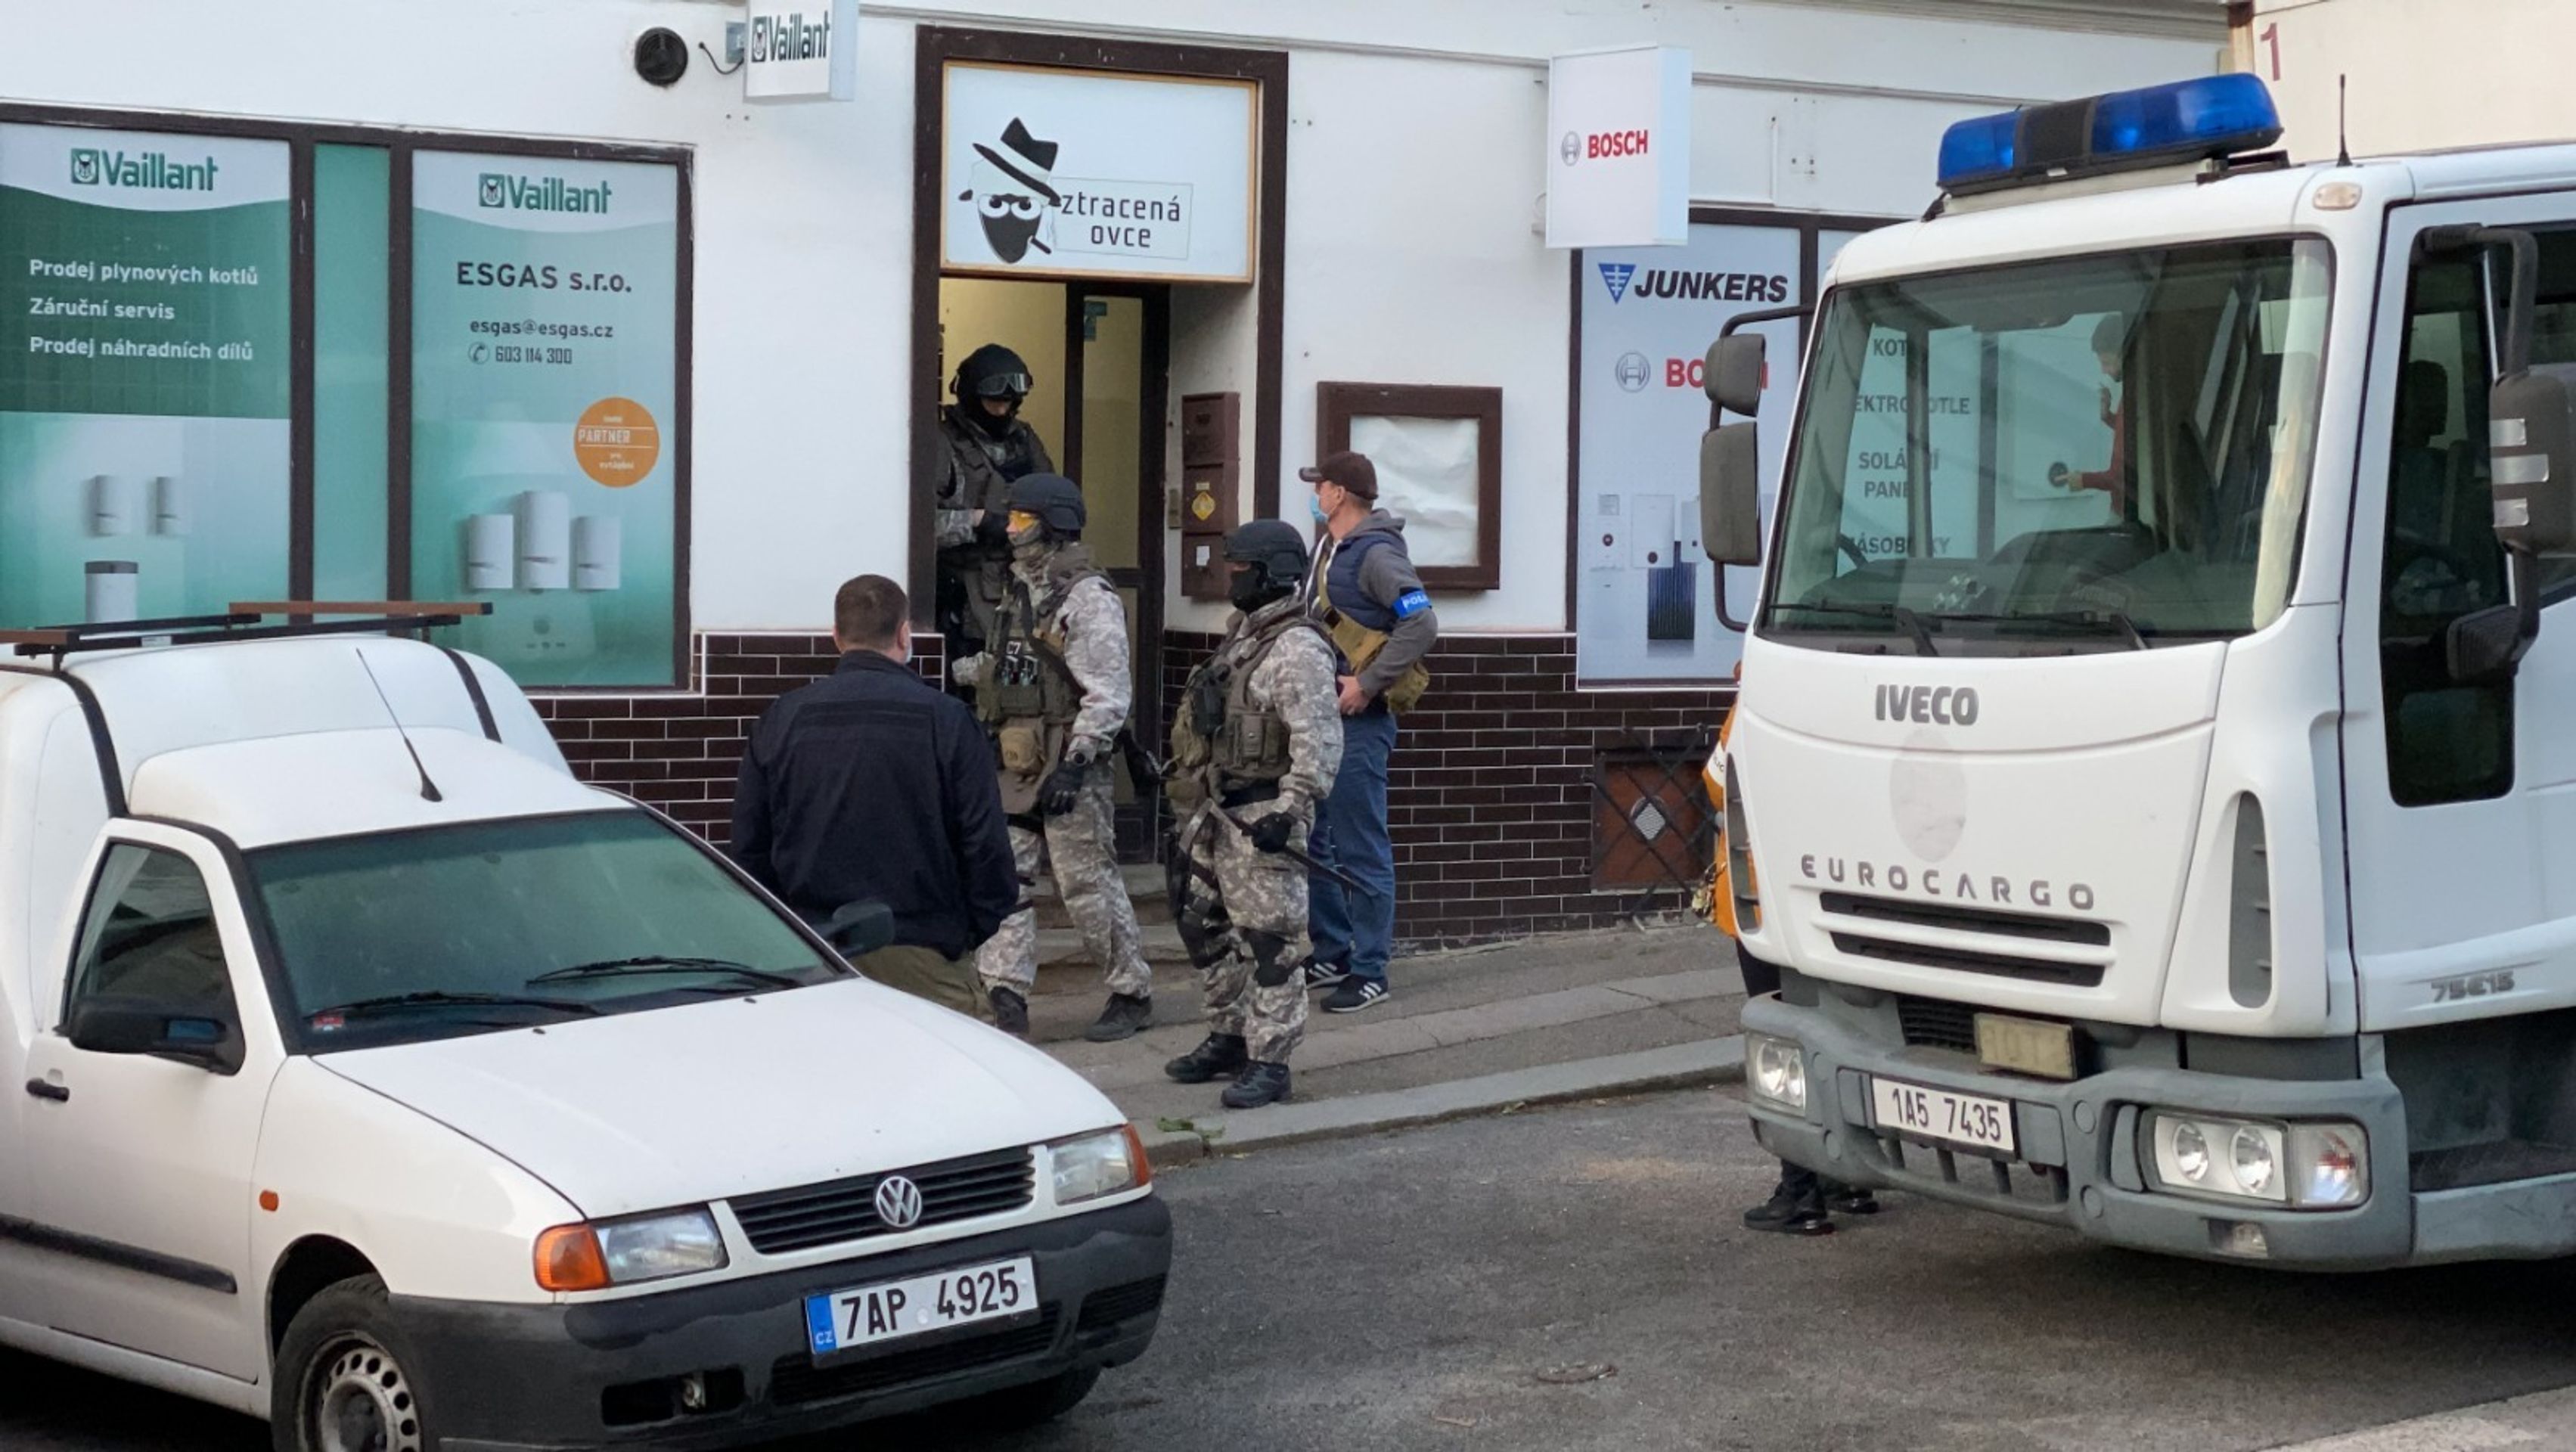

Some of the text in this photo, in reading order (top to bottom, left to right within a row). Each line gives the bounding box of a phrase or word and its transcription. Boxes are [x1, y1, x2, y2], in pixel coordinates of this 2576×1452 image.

[768, 11, 830, 61] Vaillant
[2260, 23, 2280, 81] 1
[1587, 130, 1649, 158] BOSCH
[102, 150, 218, 191] Vaillant
[507, 175, 612, 213] Vaillant
[1061, 191, 1180, 222] ztracená
[1091, 225, 1150, 248] ovce
[30, 259, 258, 285] Prodej plynových kotlů
[458, 262, 632, 293] ESGAS s.r.o.
[1635, 270, 1788, 302] JUNKERS
[30, 297, 175, 320] Záruční servis
[470, 319, 613, 340] esgas@esgas.cz
[30, 337, 253, 360] Prodej náhradních dílů
[495, 346, 573, 364] 603 114 300
[1873, 339, 1908, 357] KOT
[578, 429, 631, 443] PARTNER
[1875, 684, 1979, 726] IVECO
[1801, 853, 2094, 910] EUROCARGO
[1892, 1088, 2001, 1141] 1A5 7435
[841, 1266, 1020, 1340] 7AP 4925
[816, 1331, 833, 1345] CZ
